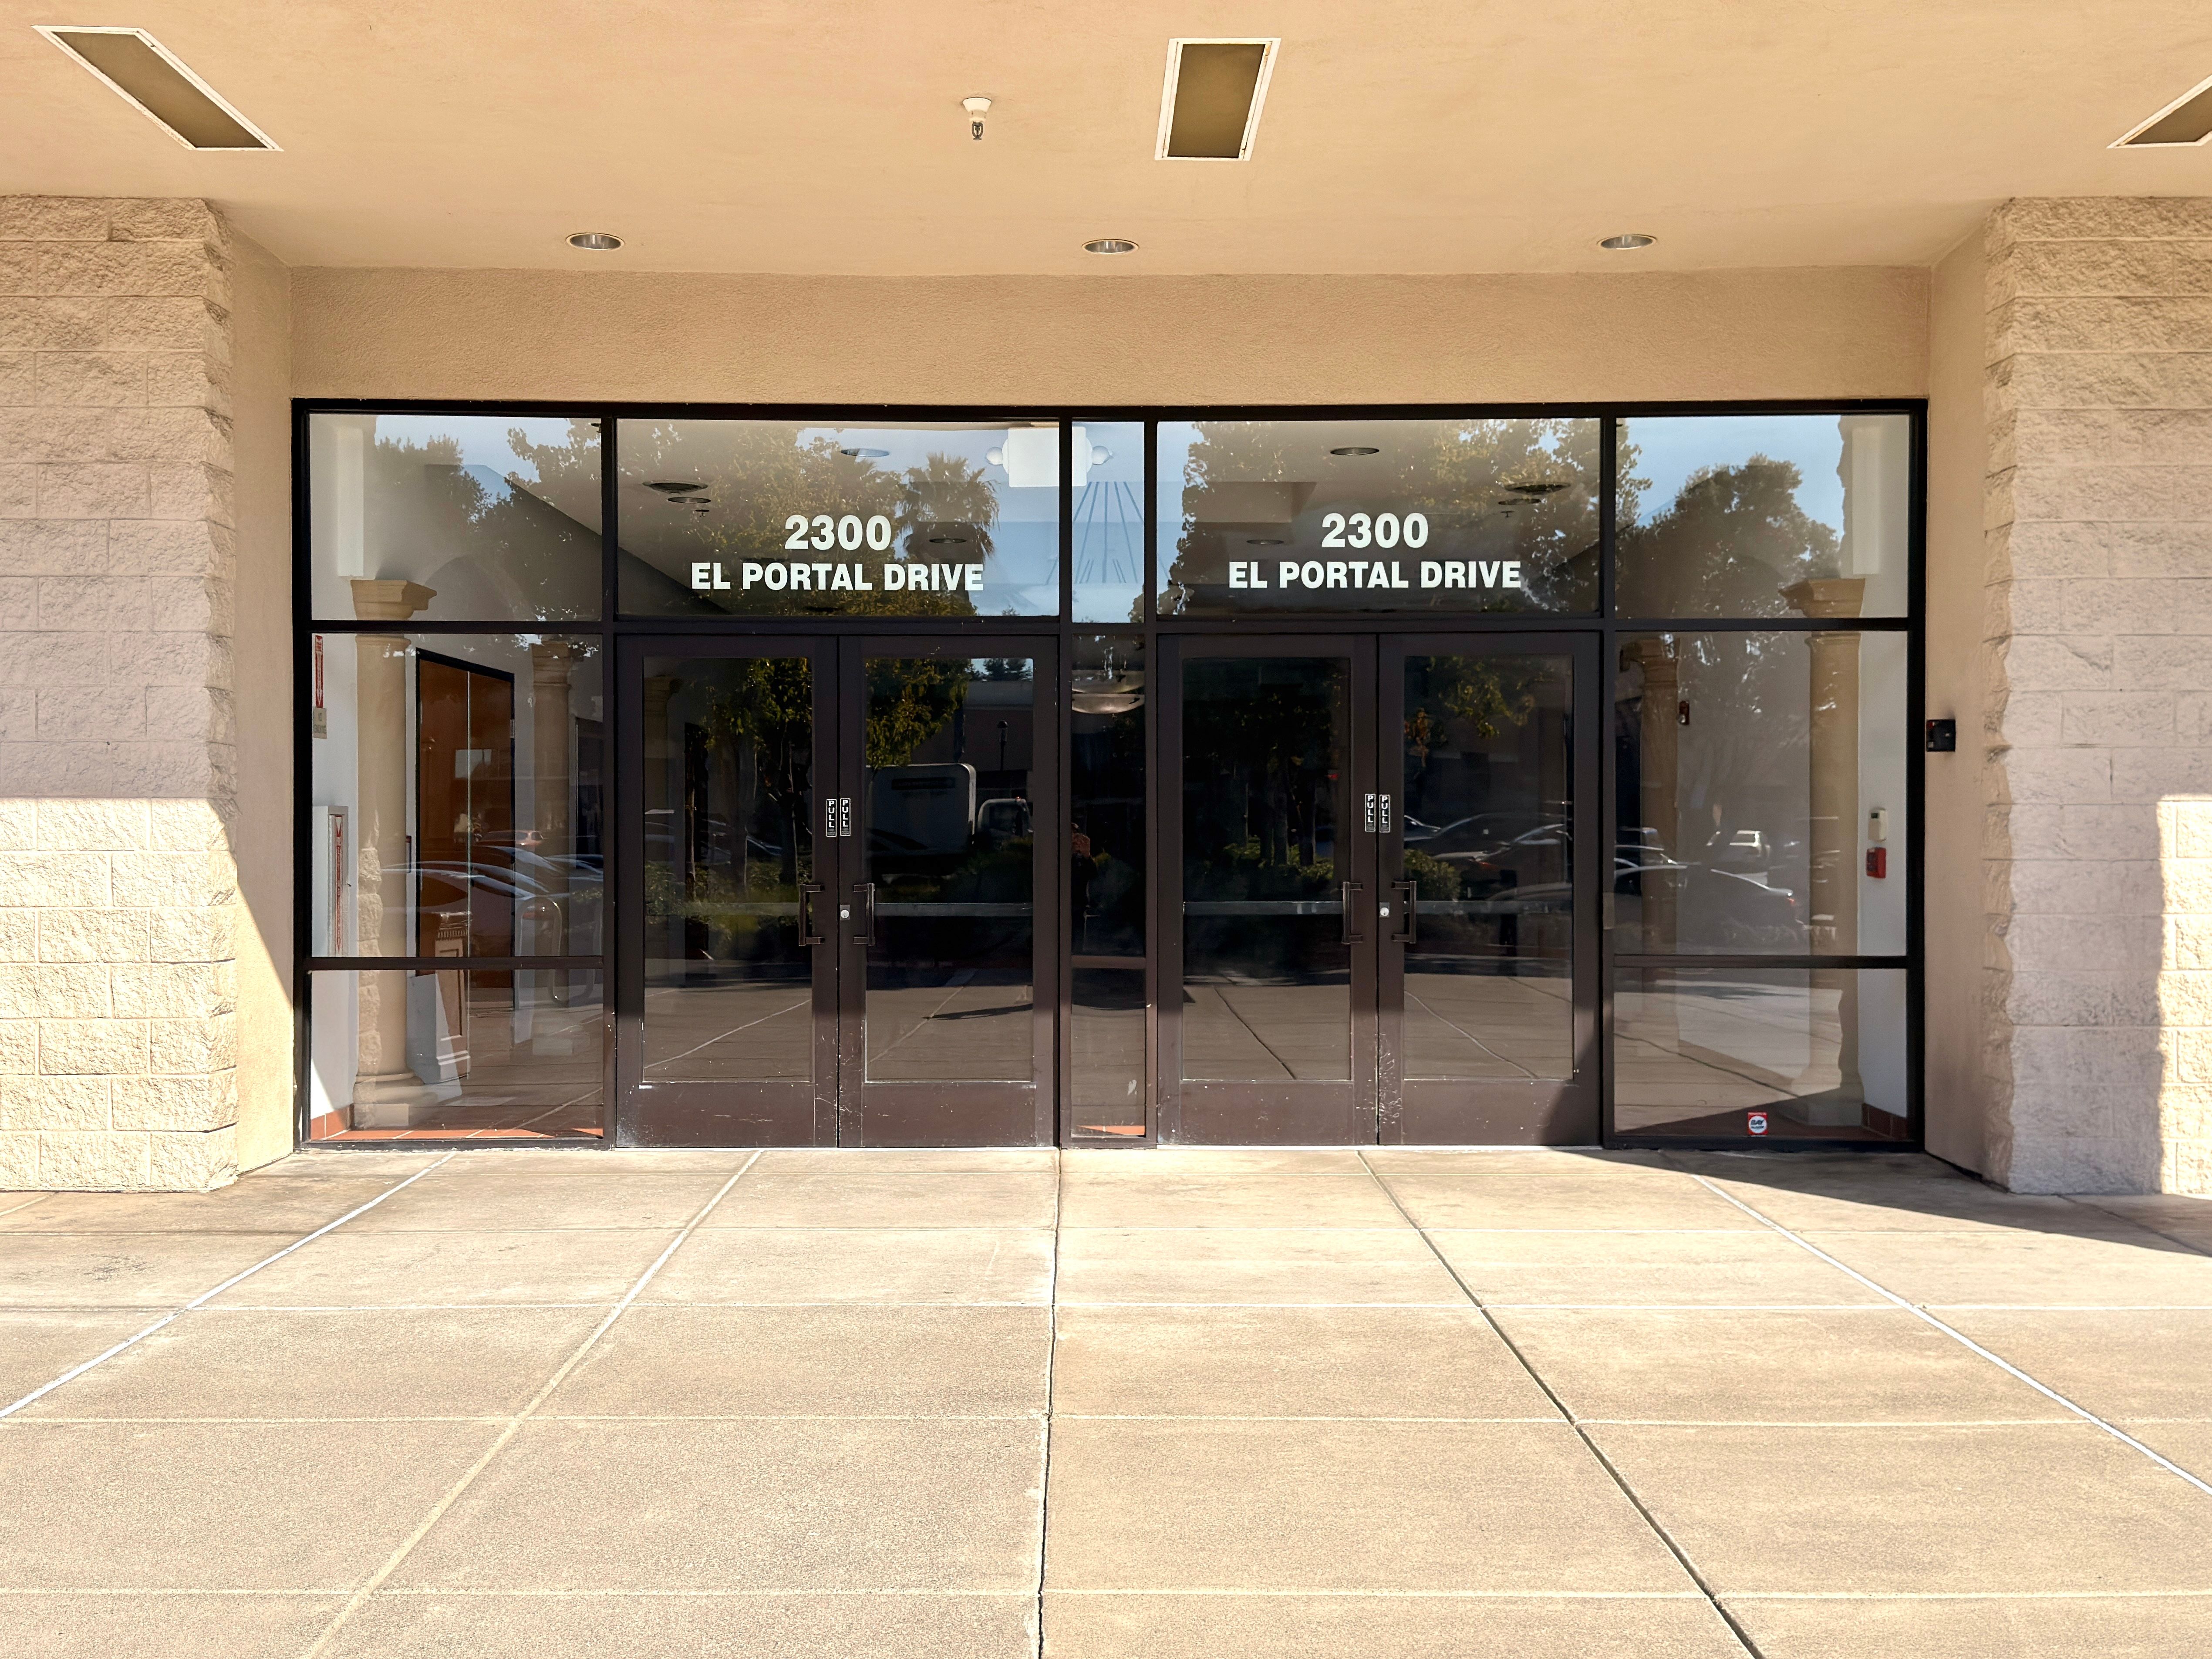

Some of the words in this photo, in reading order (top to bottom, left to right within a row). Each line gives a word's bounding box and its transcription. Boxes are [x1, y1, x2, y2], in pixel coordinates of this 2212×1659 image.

[784, 514, 891, 551] 2300
[1321, 513, 1429, 549] 2300
[691, 562, 731, 590] EL
[742, 562, 873, 591] PORTAL
[884, 563, 984, 591] DRIVE
[1229, 561, 1268, 589] EL
[1279, 560, 1409, 589] PORTAL
[1420, 560, 1521, 588] DRIVE
